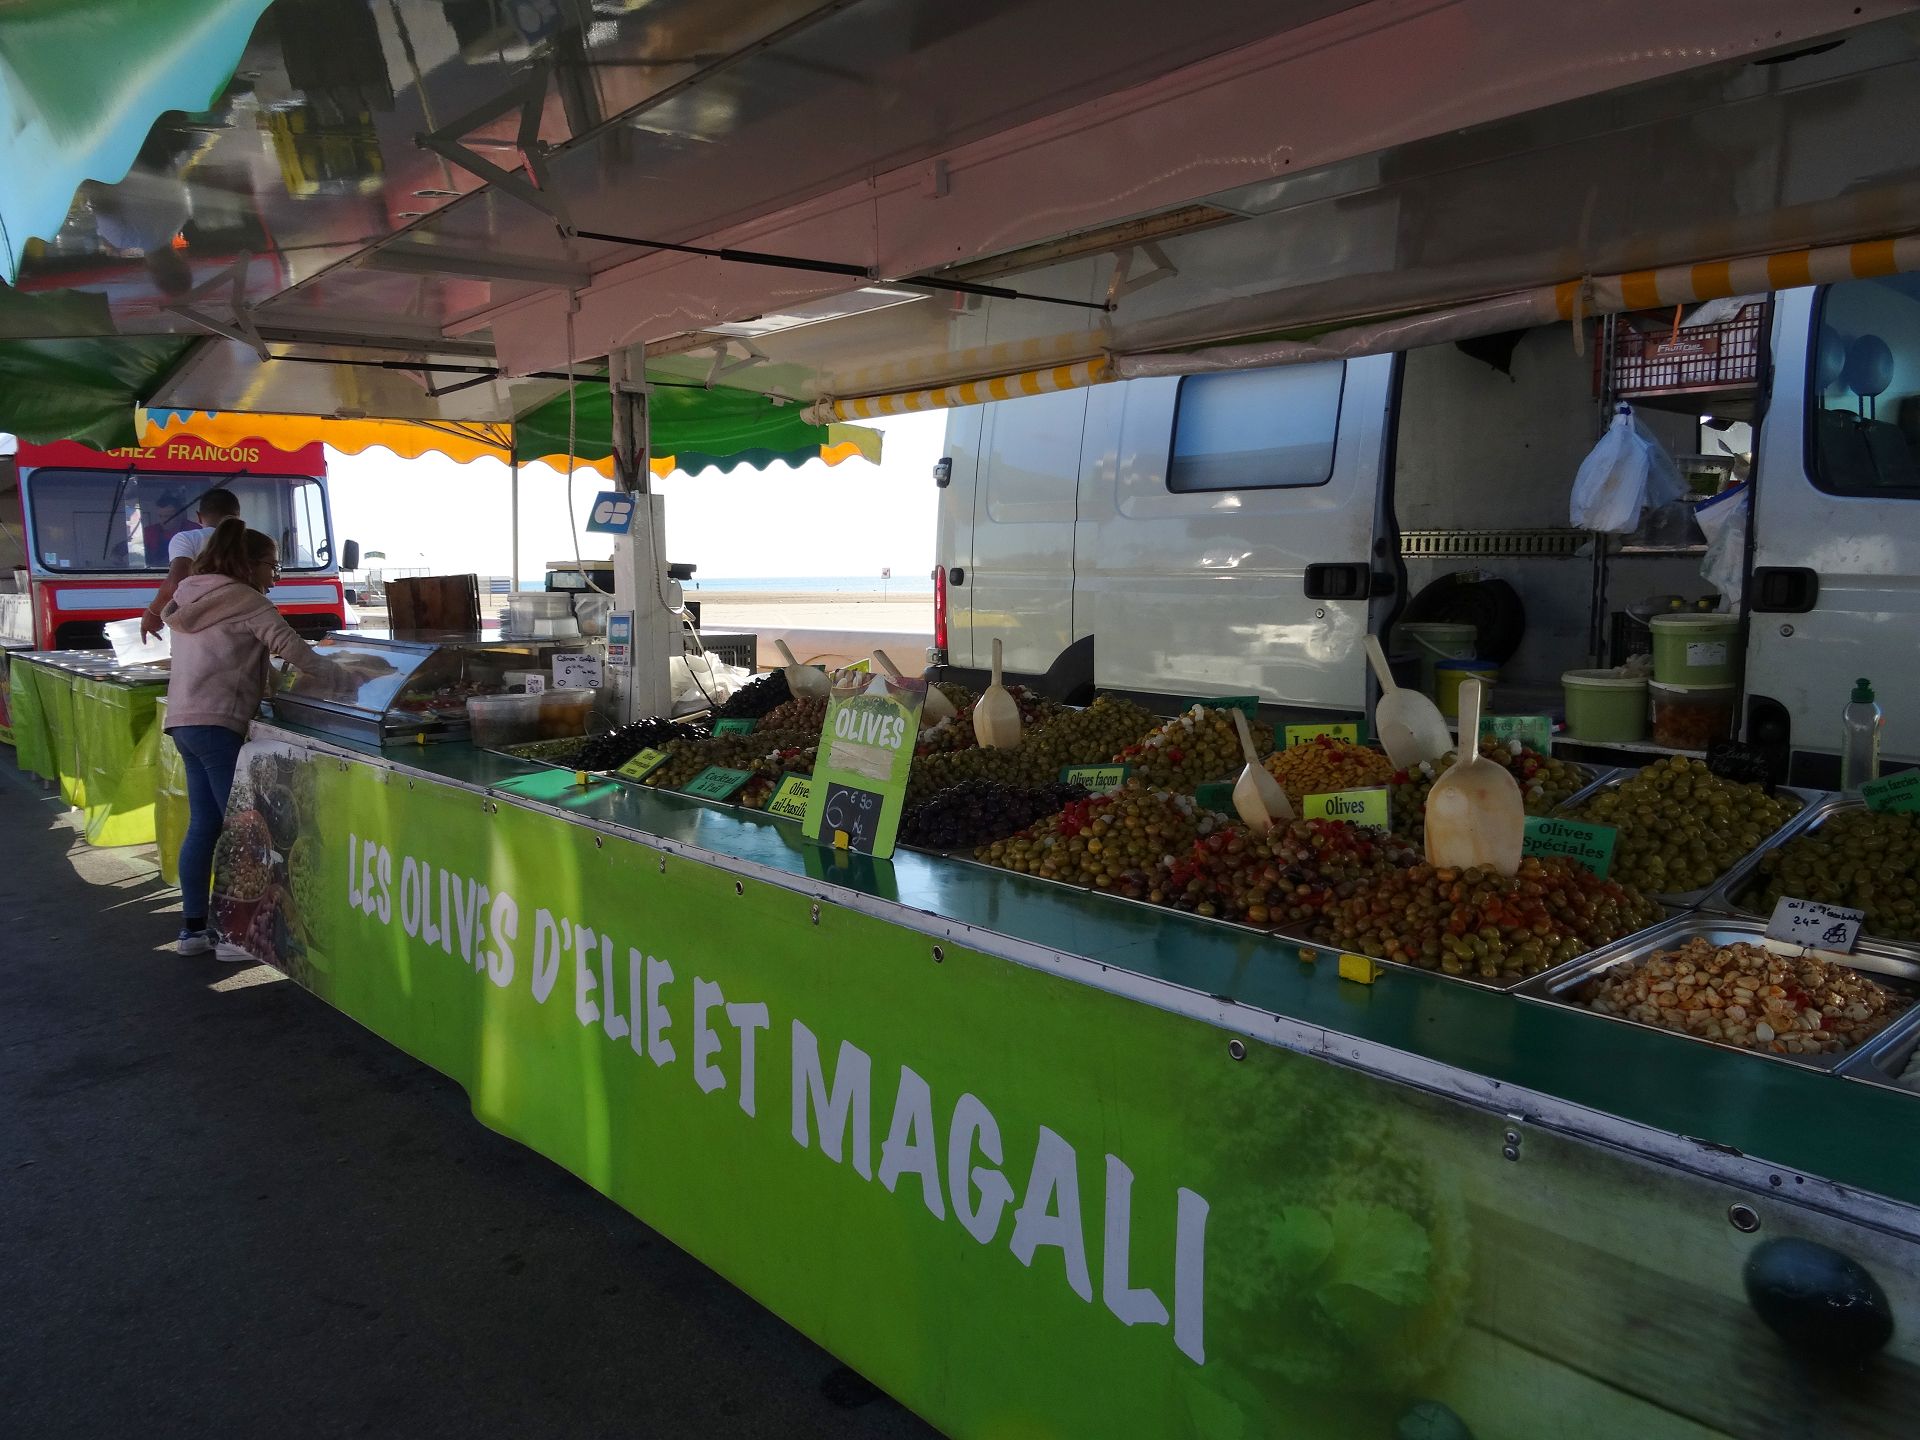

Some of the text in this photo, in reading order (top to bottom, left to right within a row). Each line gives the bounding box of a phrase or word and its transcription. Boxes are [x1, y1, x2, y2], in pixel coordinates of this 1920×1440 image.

[167, 444, 259, 463] FRANCOIS
[835, 708, 905, 749] OLIVES
[705, 772, 741, 785] Cocktail
[1070, 771, 1118, 789] Olives façon
[771, 797, 809, 816] ail-basili
[1325, 796, 1365, 815] Olives
[1539, 822, 1593, 841] Olives
[1523, 836, 1605, 859] Spéciales
[348, 833, 1210, 1366] LES OLIVES D'ELIE ET MAGALI
